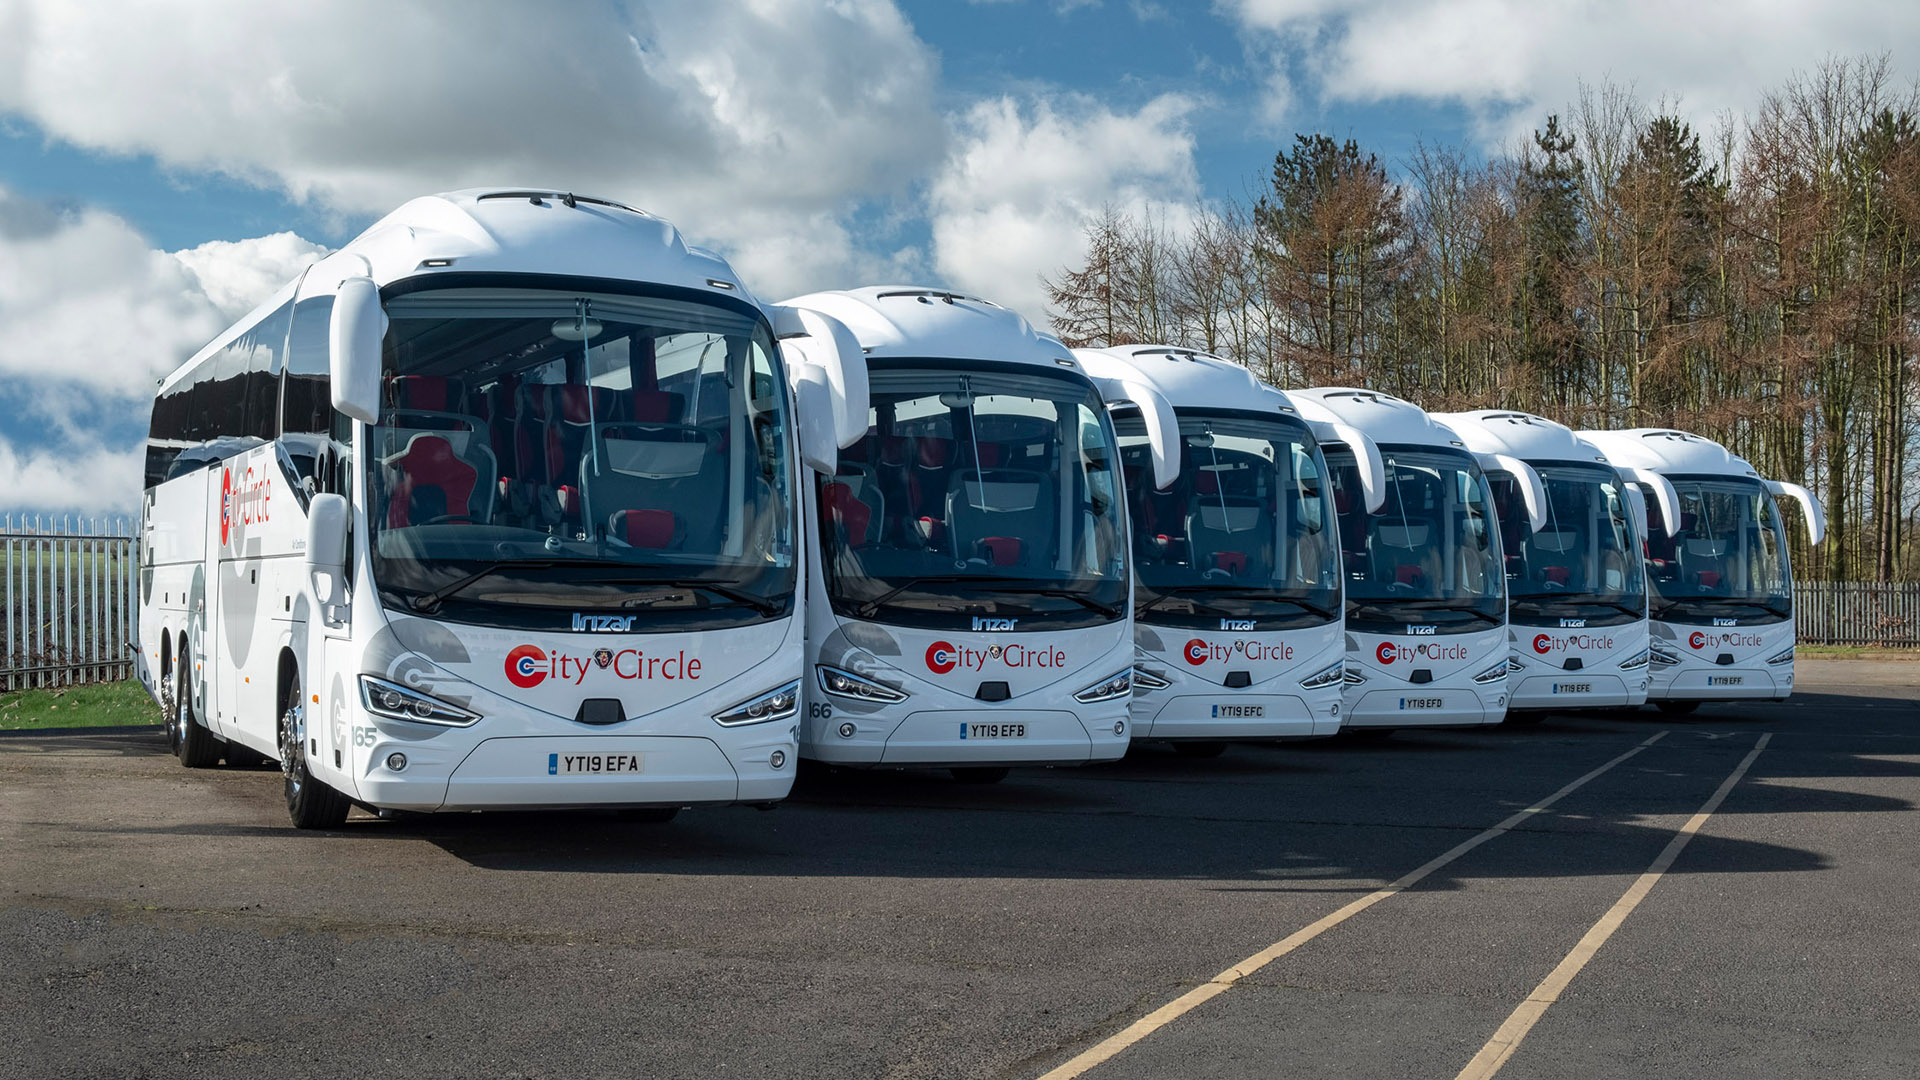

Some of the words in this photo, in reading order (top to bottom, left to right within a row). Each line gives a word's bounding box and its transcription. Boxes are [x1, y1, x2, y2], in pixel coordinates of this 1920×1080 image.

[221, 467, 242, 546] City
[244, 463, 271, 525] Circle
[572, 612, 637, 632] Irizar
[971, 616, 1018, 631] Irizar
[1220, 618, 1257, 631] Irizar
[1407, 624, 1438, 635] Irizar
[1532, 633, 1570, 655] City
[1577, 634, 1614, 650] Circle
[1688, 631, 1722, 650] City
[1729, 632, 1762, 647] Circle
[925, 640, 988, 675] City
[1003, 644, 1066, 668] Circle
[1183, 638, 1233, 666] City
[1245, 641, 1294, 661] Circle
[1376, 641, 1418, 665] City
[1426, 643, 1468, 660] Circle
[504, 644, 592, 689] City
[613, 649, 702, 680] Circle
[1559, 684, 1575, 693] YT19
[1220, 706, 1242, 717] YT19
[1244, 706, 1263, 717] EFC
[1407, 699, 1425, 708] YT19
[971, 725, 998, 738] YT19
[1001, 724, 1025, 737] EFB
[564, 756, 602, 772] YT19
[606, 755, 639, 772] EFA
